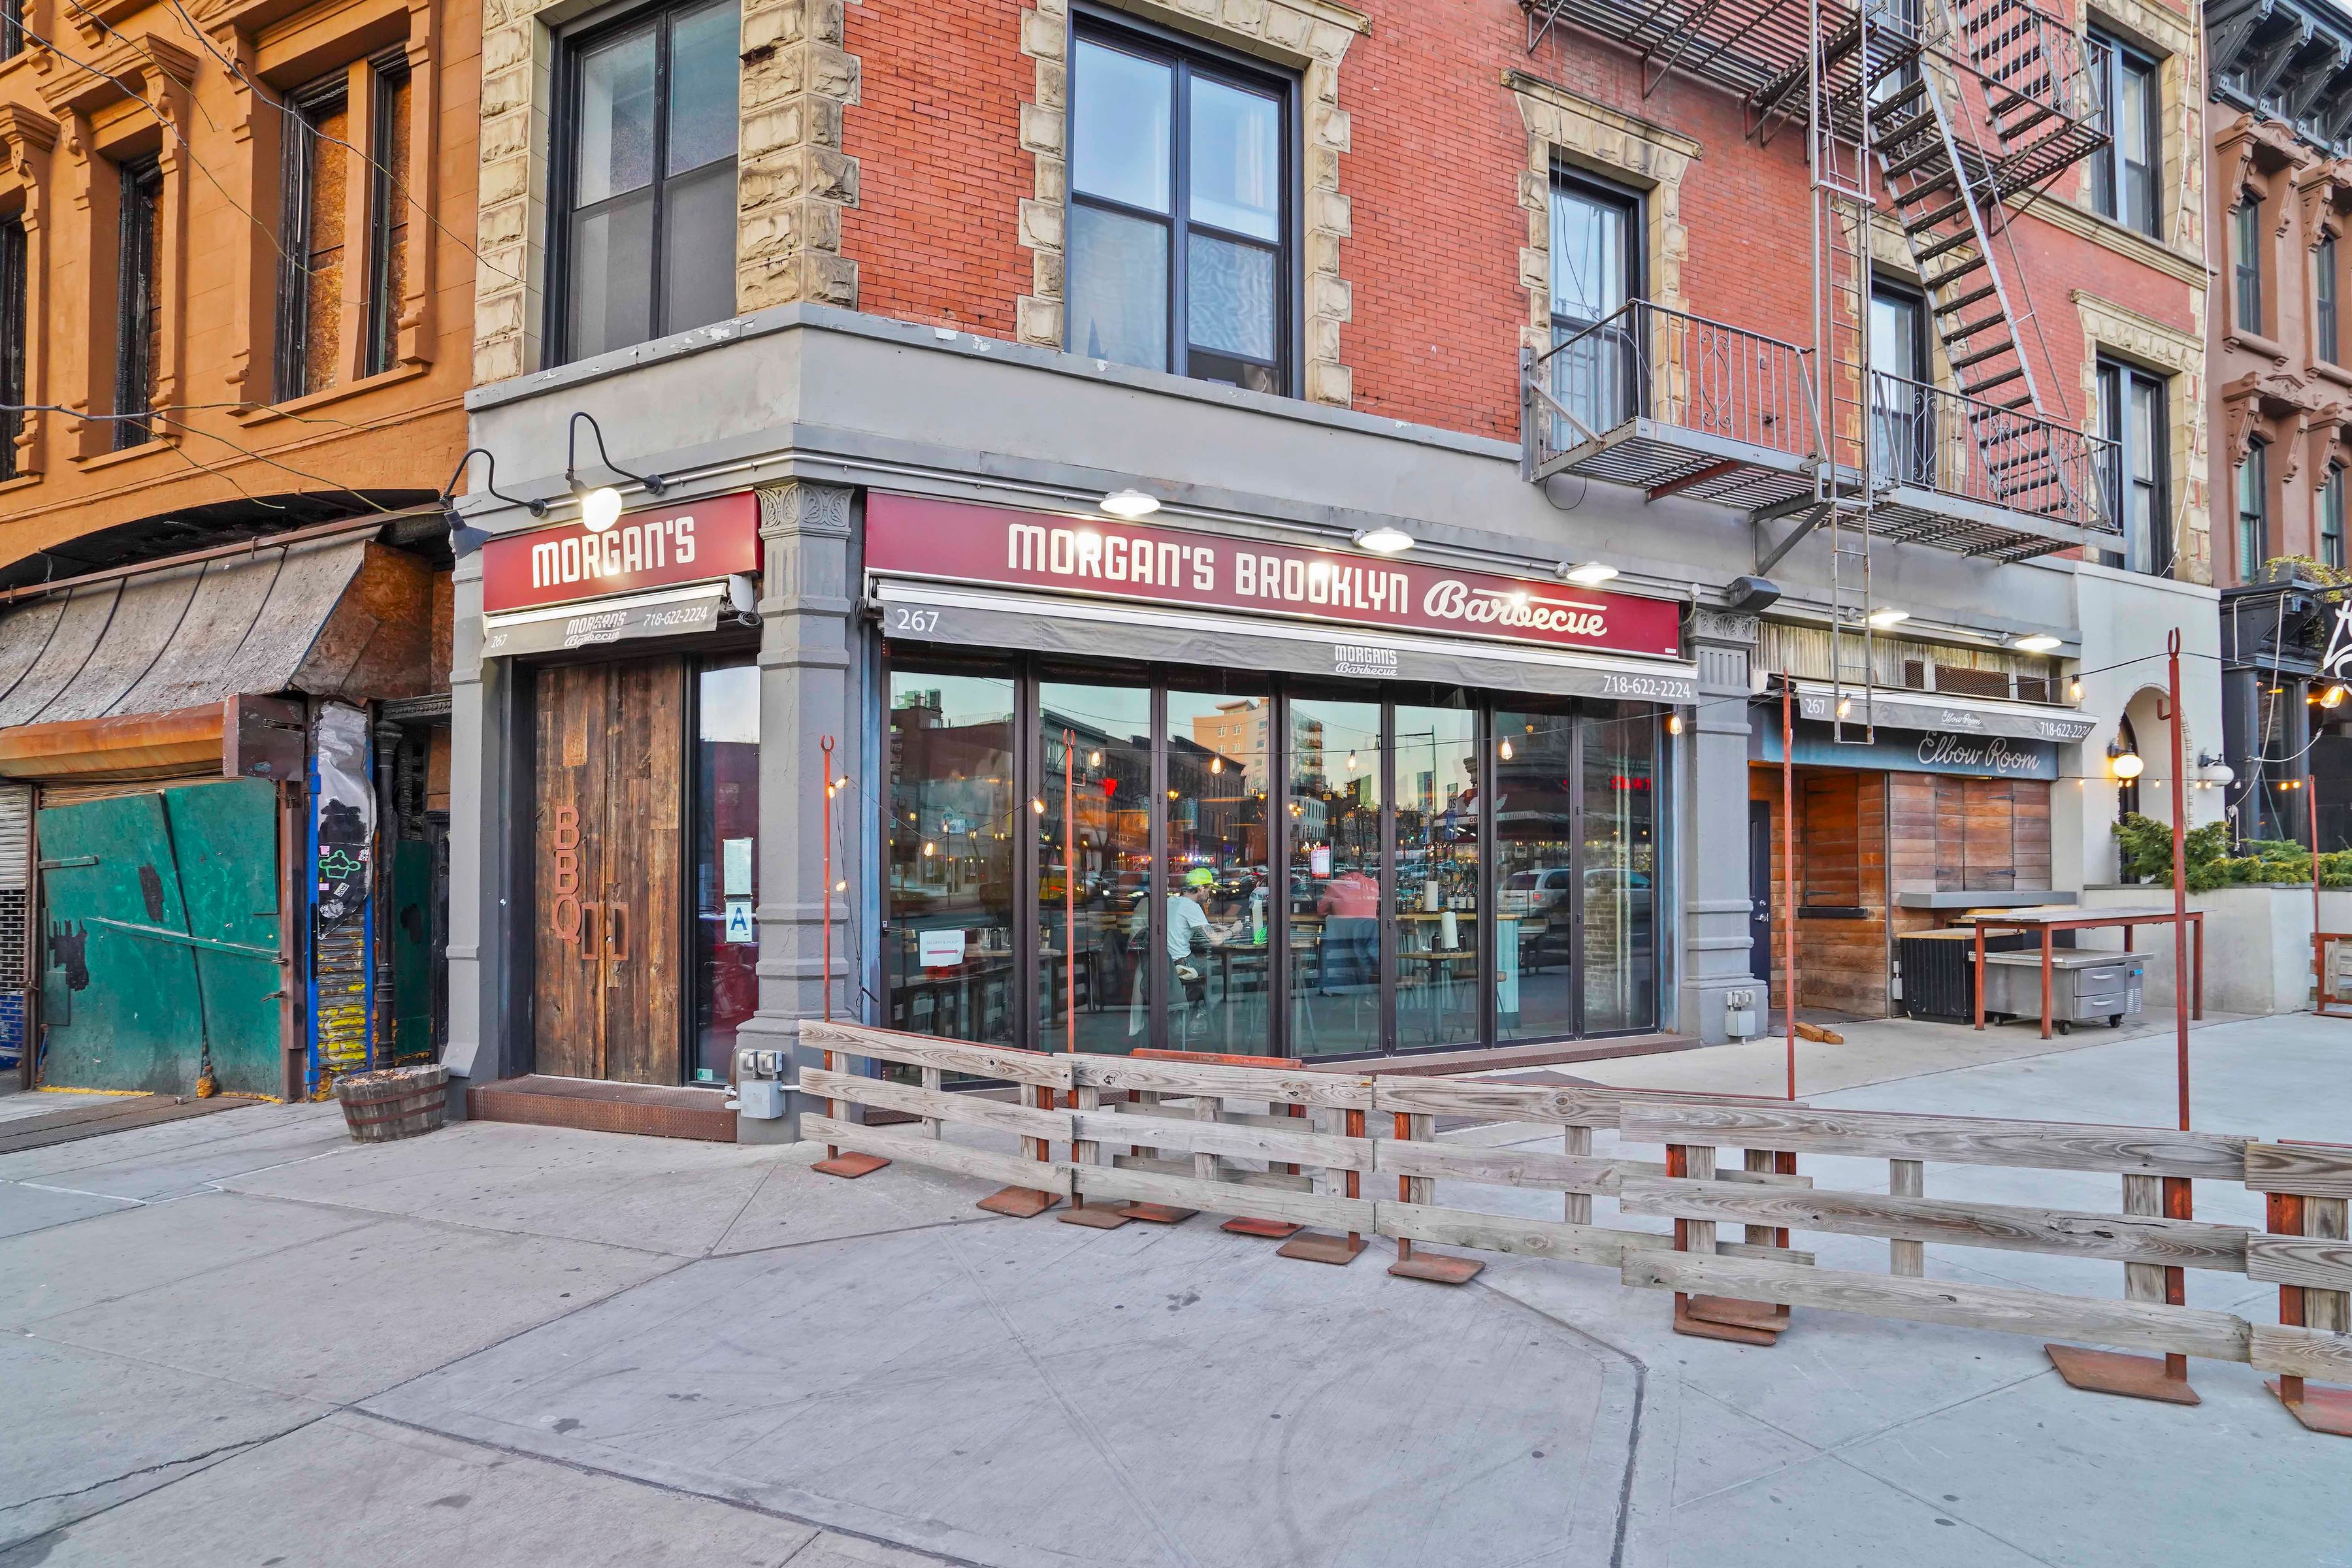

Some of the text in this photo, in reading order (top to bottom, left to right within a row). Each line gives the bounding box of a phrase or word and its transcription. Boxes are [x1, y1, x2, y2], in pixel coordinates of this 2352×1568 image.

[532, 516, 695, 588] MORGAN'S
[1008, 523, 1607, 636] MORGAN'S BROOKLYN Barbecue
[566, 611, 627, 635] MORGAN'S
[643, 606, 708, 627] 718-622-2224
[897, 608, 939, 632] 267
[491, 634, 508, 647] 267
[564, 630, 621, 647] Barbecue
[1335, 645, 1397, 664] MORGAN'S
[1335, 662, 1397, 676] Barbecue
[1604, 675, 1691, 698] 718-622-2224
[1805, 698, 1825, 714] 267
[1918, 730, 2040, 774] Elbow Room
[551, 806, 582, 945] BBQ
[730, 907, 747, 930] A
